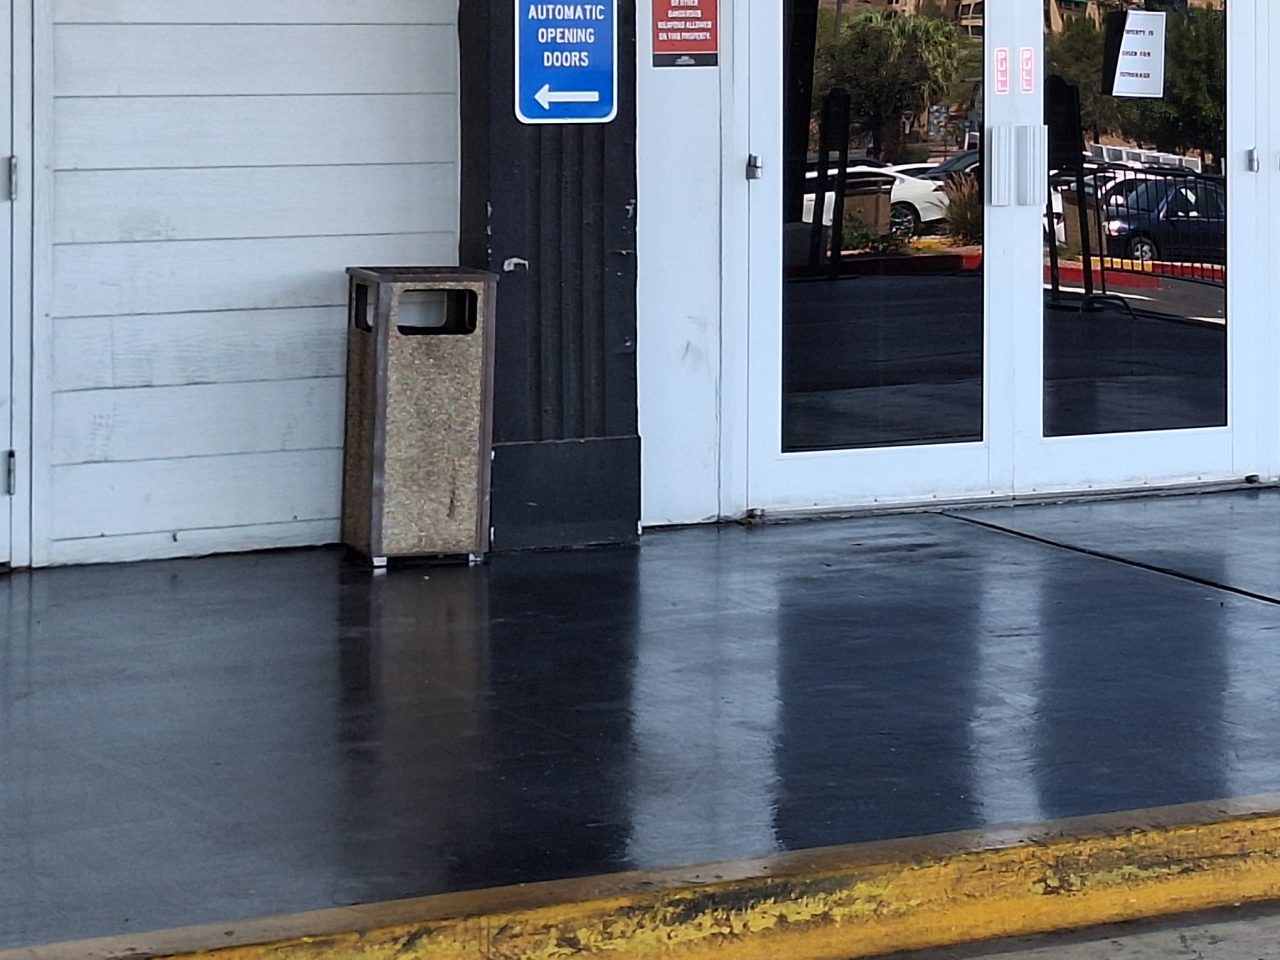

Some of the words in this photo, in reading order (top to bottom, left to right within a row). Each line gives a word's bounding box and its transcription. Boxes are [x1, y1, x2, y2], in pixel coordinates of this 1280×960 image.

[528, 5, 605, 20] AUTOMATIC
[538, 28, 595, 43] OPENING
[543, 51, 589, 67] DOORS
[997, 52, 1007, 91] PULL
[1022, 52, 1032, 91] PULL
